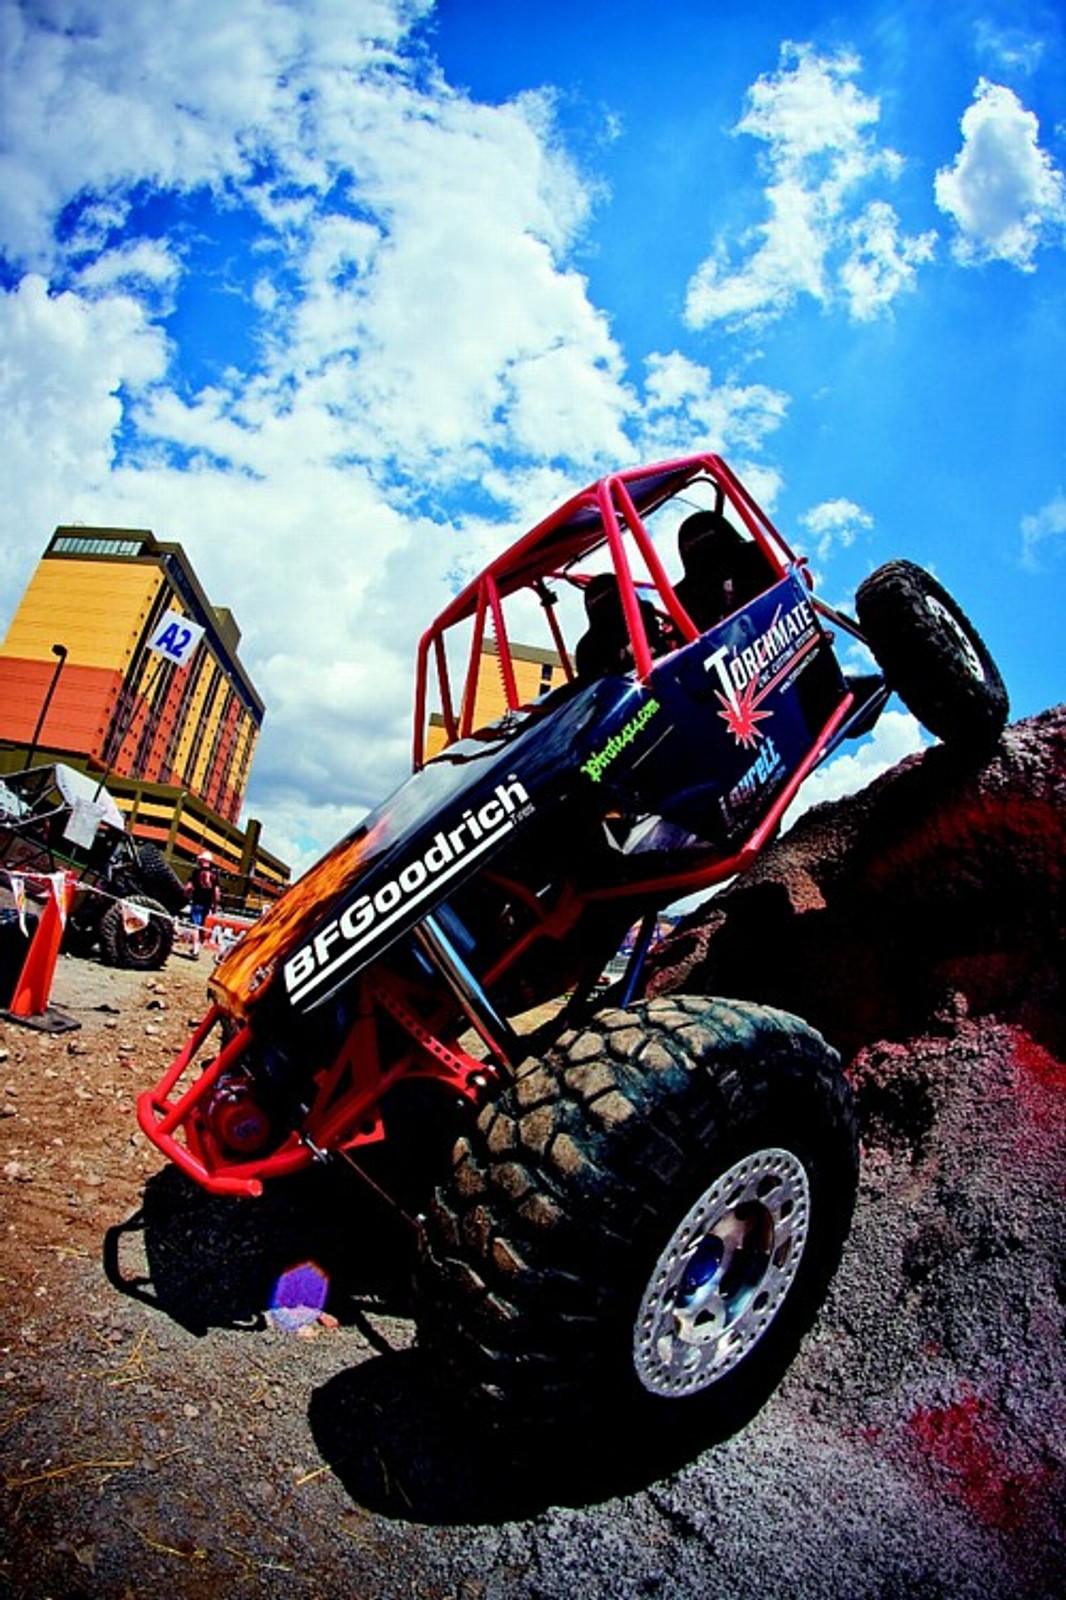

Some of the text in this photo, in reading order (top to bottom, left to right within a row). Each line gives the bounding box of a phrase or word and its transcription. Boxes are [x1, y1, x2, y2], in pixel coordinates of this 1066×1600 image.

[155, 622, 192, 658] A2
[703, 601, 814, 717] TORCHMATE
[284, 783, 529, 993] BFGoodrich
